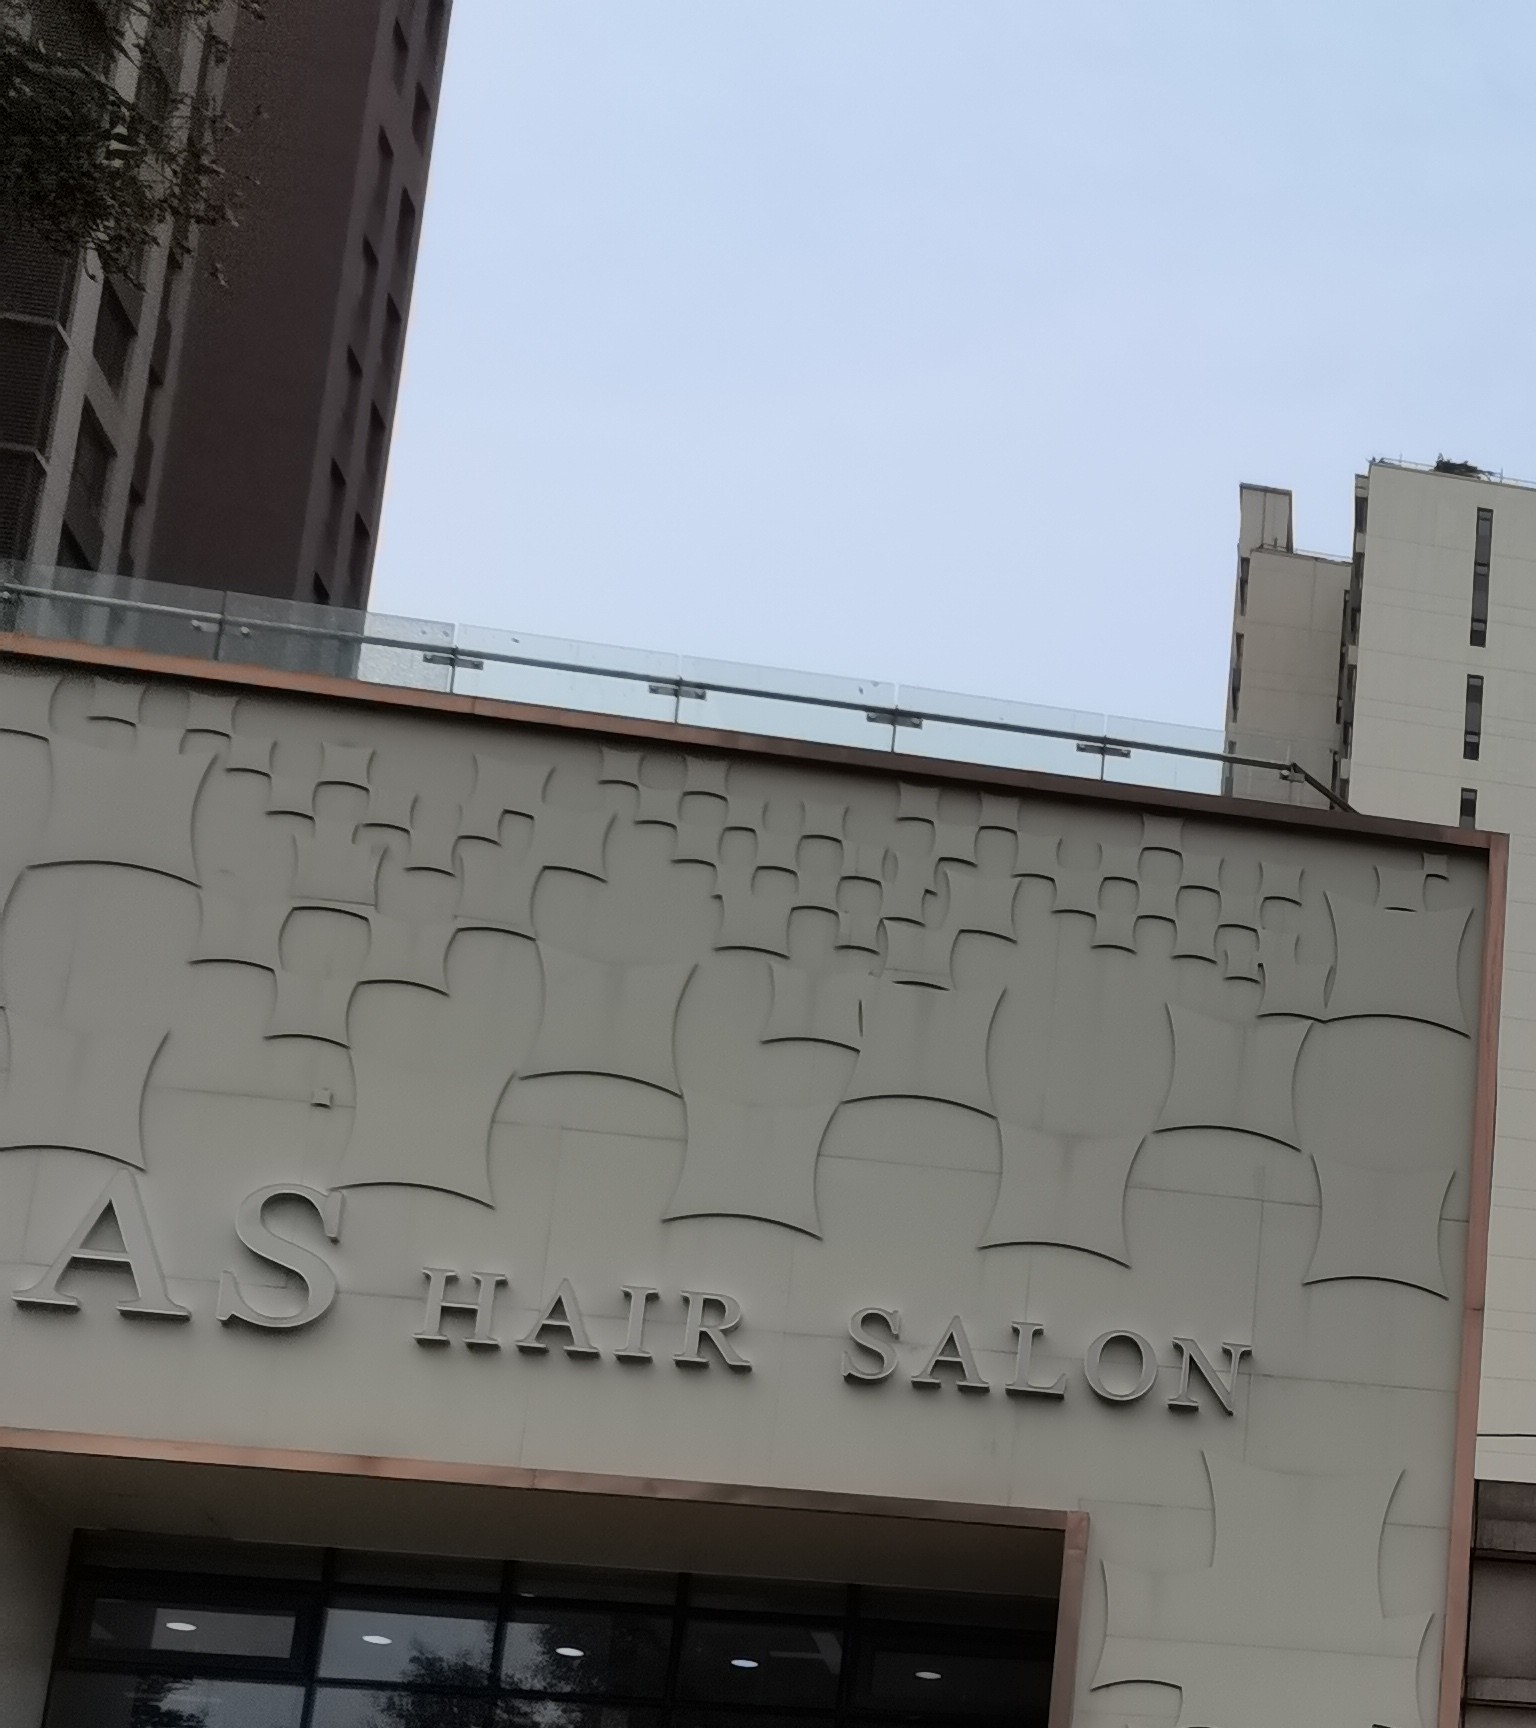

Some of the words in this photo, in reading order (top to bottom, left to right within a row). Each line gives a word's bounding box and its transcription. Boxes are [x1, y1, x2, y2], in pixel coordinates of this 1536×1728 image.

[12, 1168, 347, 1330] AS
[413, 1266, 753, 1372] HAIR
[841, 1306, 1252, 1417] SALON
